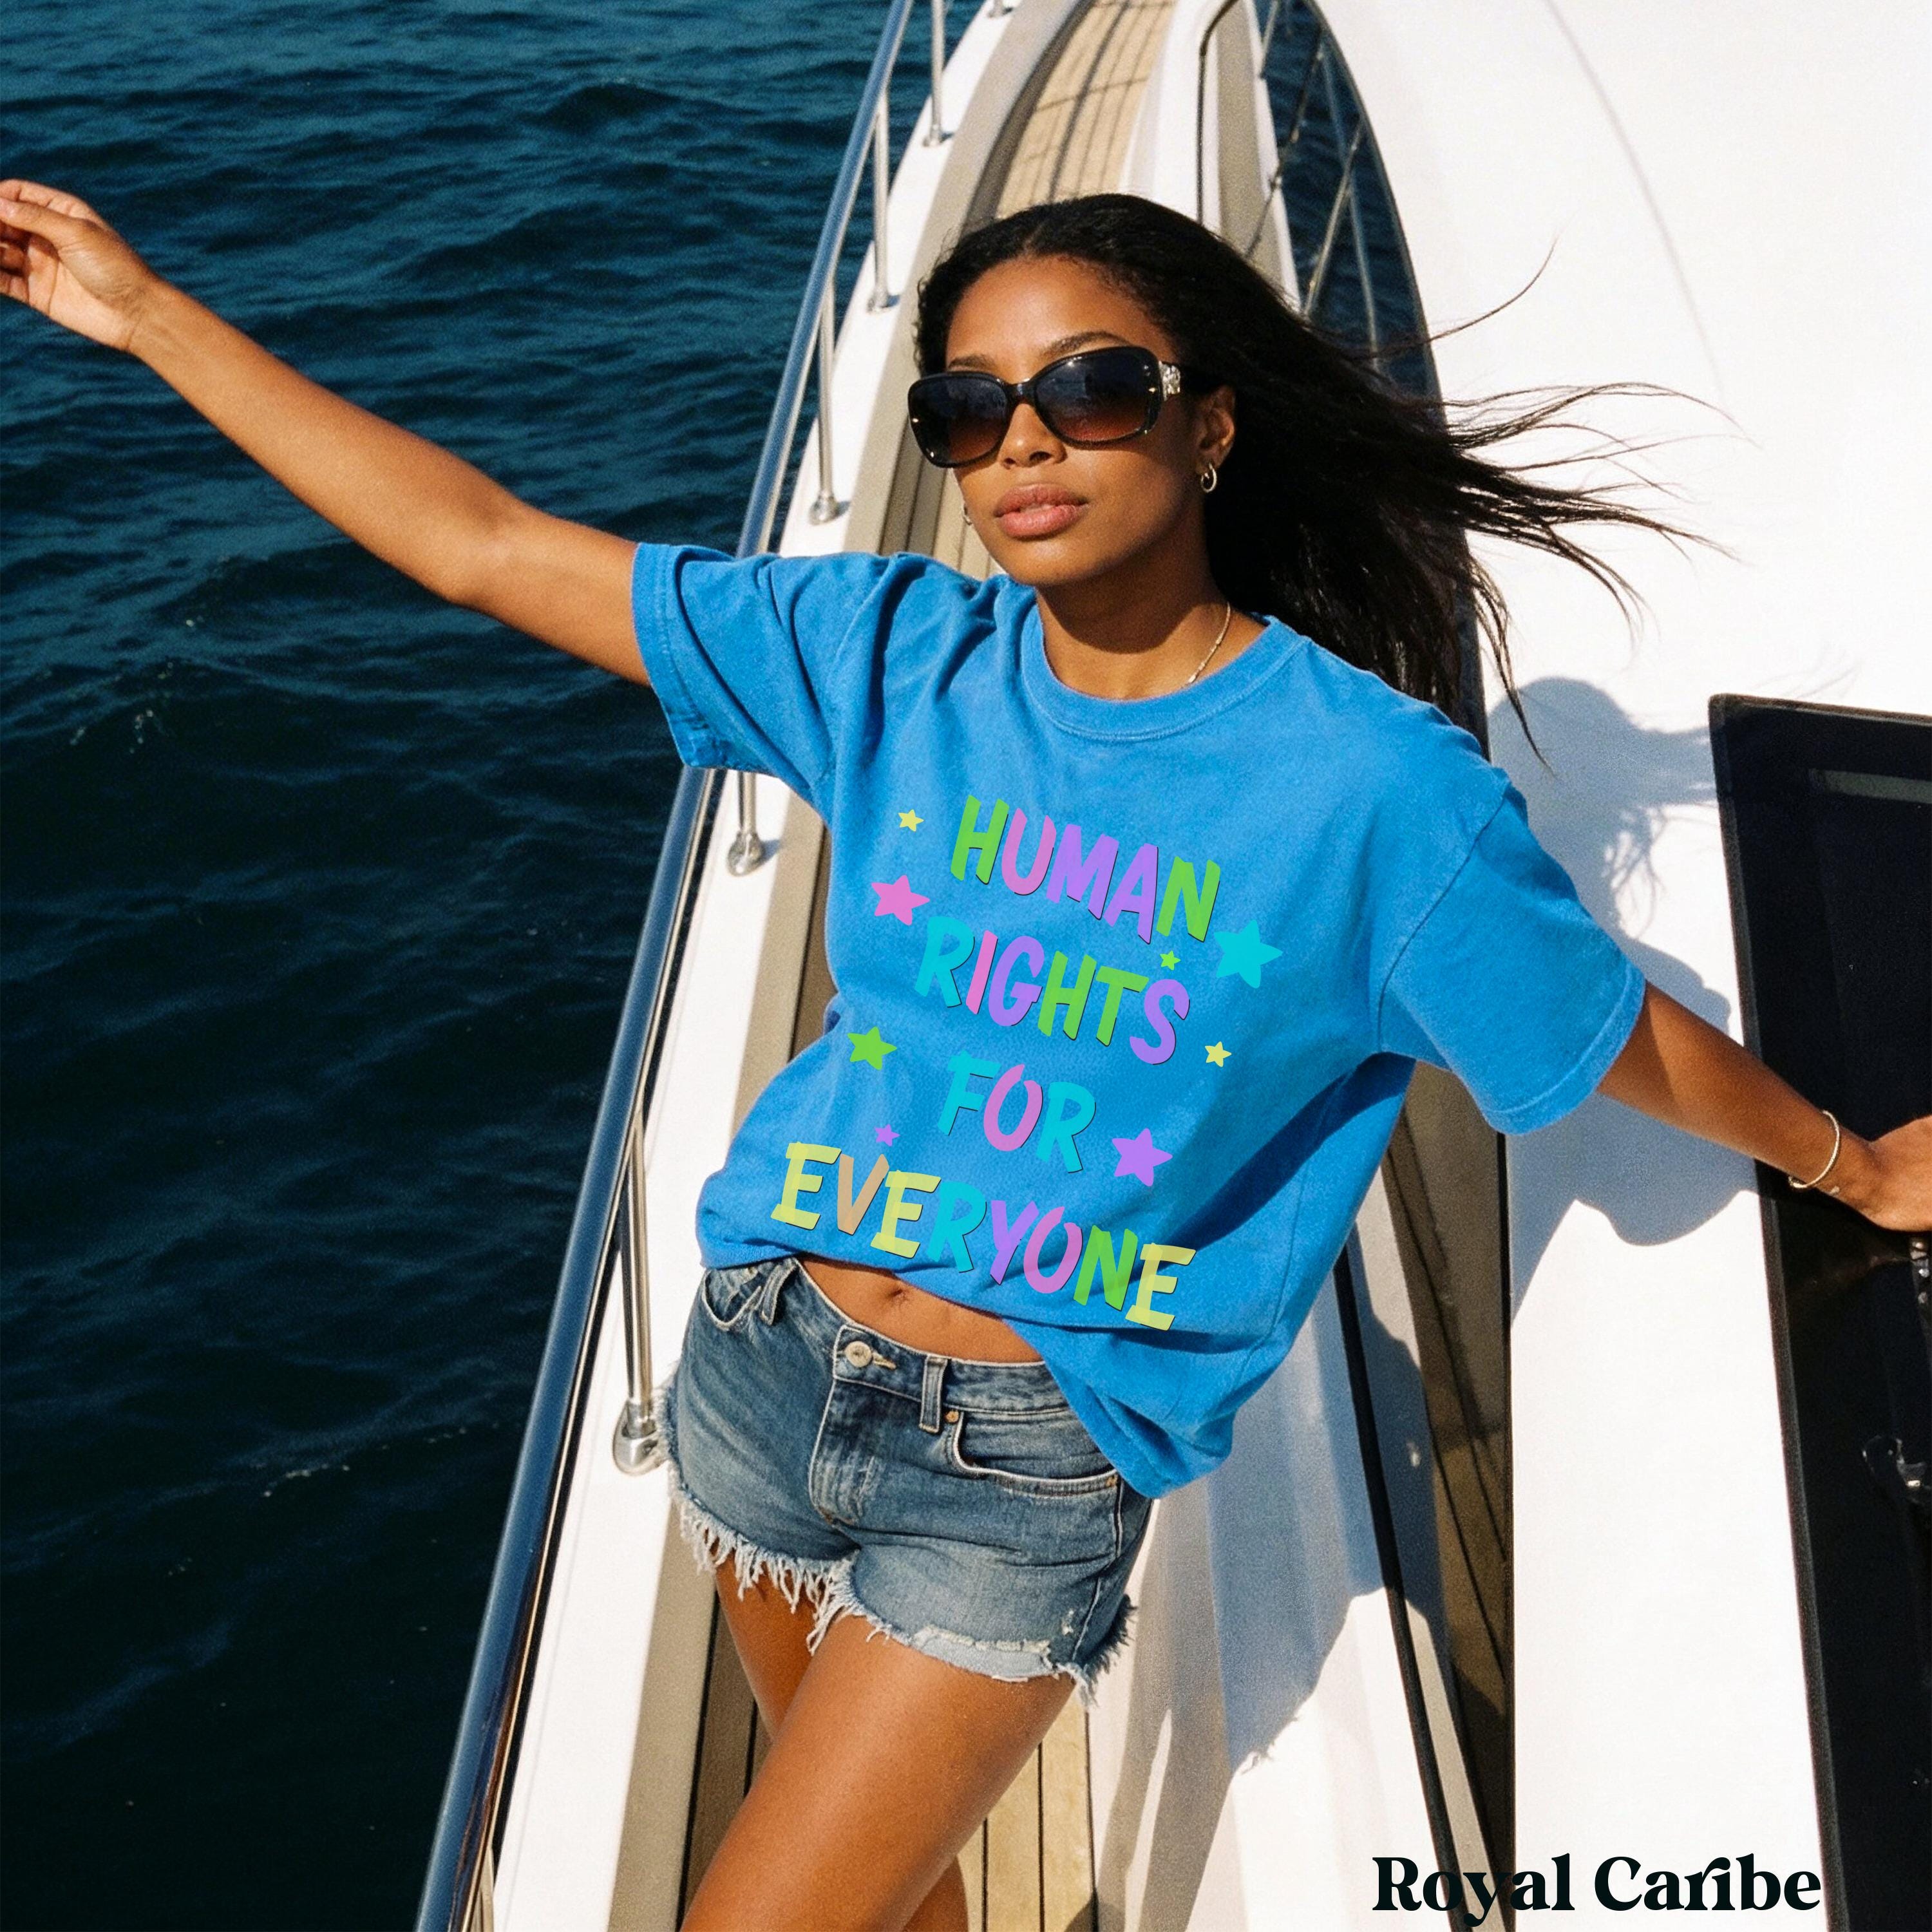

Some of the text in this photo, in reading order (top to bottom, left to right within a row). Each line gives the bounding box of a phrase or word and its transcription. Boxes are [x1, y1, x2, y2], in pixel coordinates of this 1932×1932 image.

[950, 795, 1221, 944] HUMAN
[914, 916, 1190, 1065] RIGHTS
[937, 1051, 1096, 1173] FOR
[771, 1141, 1197, 1331] EVERYONE
